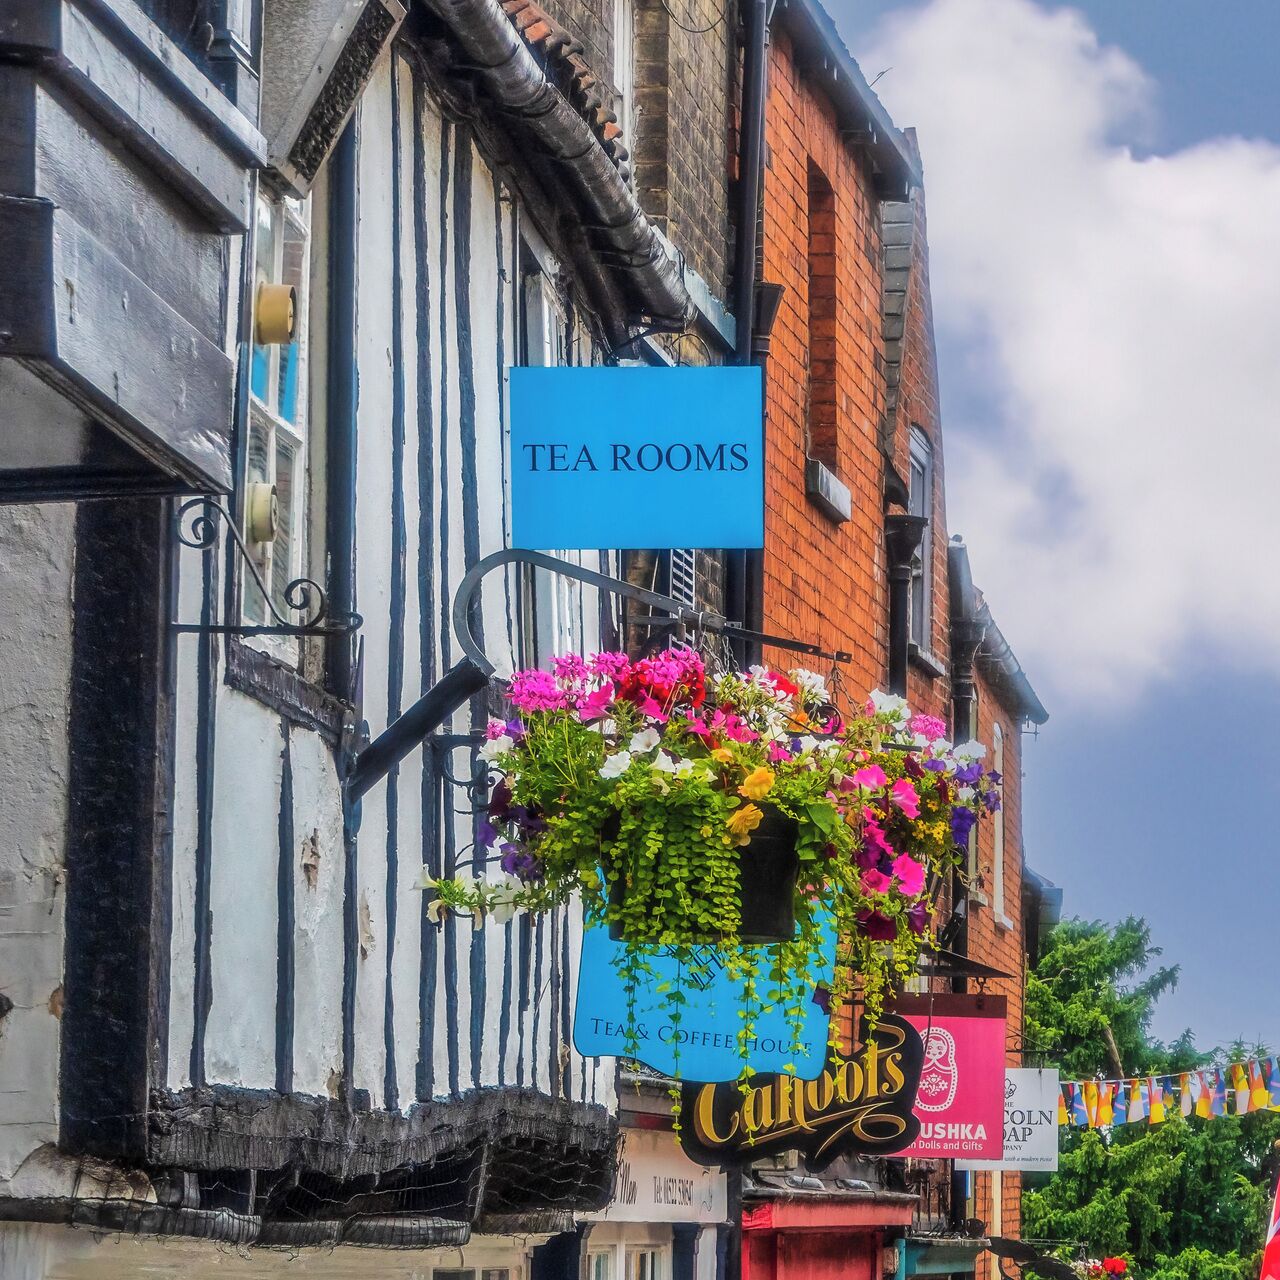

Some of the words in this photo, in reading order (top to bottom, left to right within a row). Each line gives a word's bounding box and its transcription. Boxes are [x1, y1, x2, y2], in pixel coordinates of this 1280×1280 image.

[522, 444, 597, 472] TEA
[610, 443, 749, 472] ROOMS
[590, 1018, 627, 1038] TEA
[635, 1022, 650, 1040] &
[658, 1025, 733, 1049] COFFEE
[1002, 1110, 1054, 1126] COLN
[920, 1122, 987, 1140] USHKA
[919, 1140, 941, 1150] Dolls
[943, 1140, 959, 1150] and
[962, 1141, 983, 1151] Gifts
